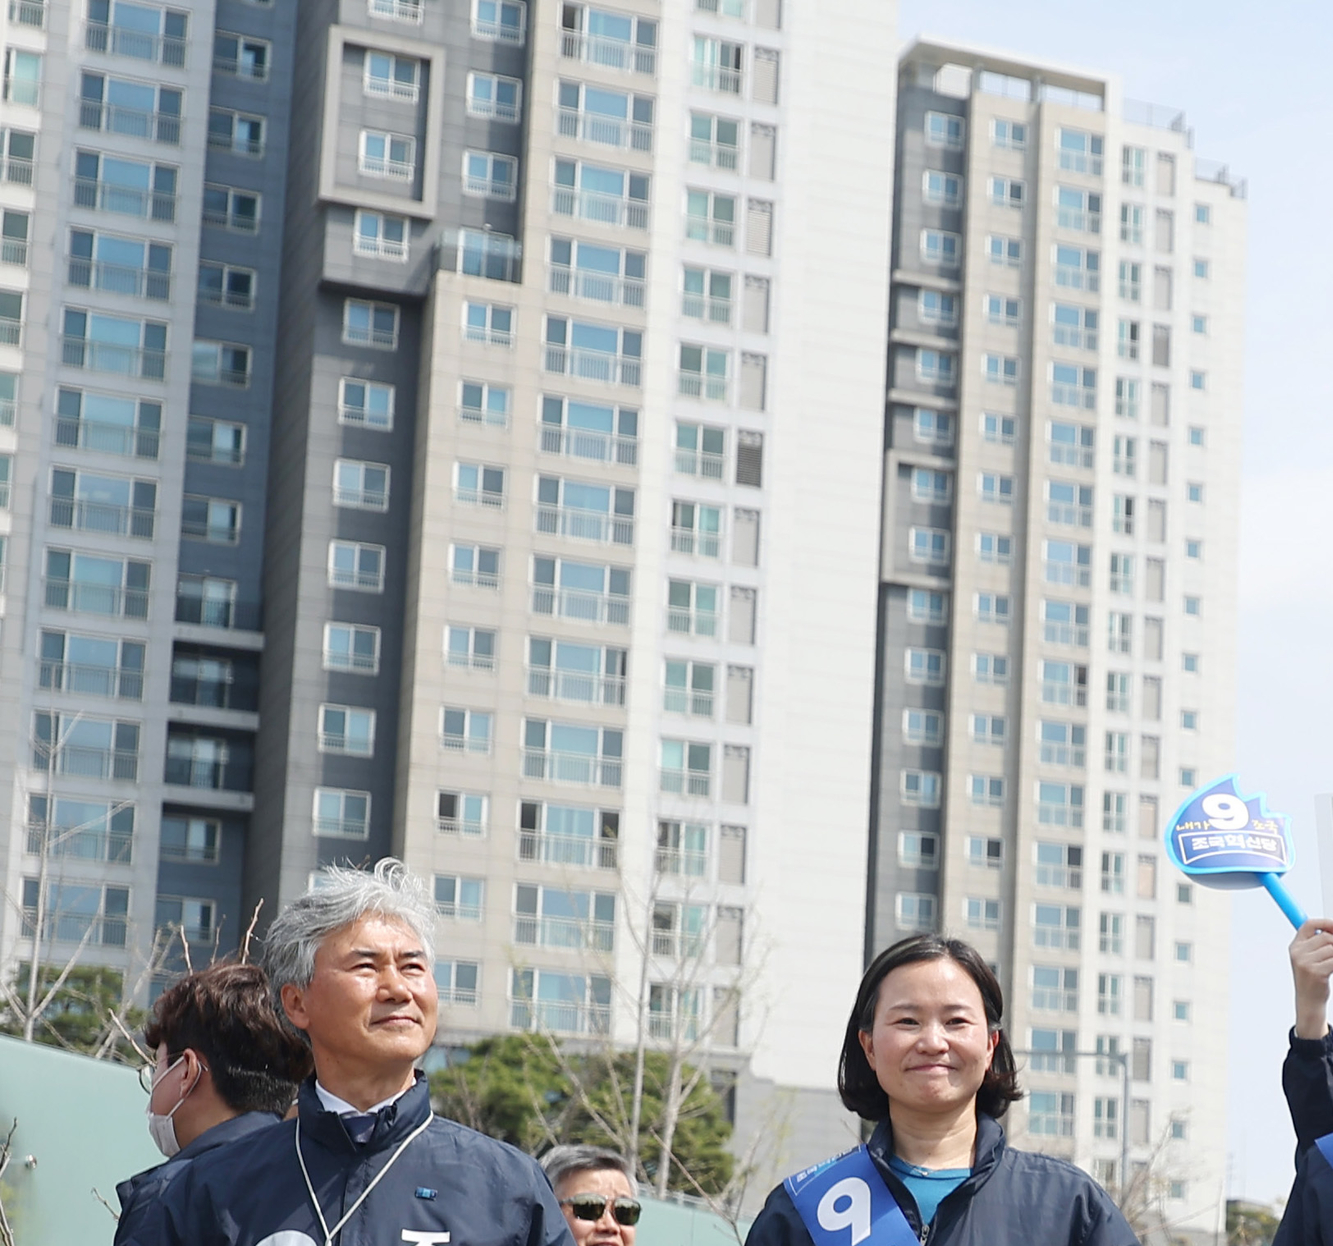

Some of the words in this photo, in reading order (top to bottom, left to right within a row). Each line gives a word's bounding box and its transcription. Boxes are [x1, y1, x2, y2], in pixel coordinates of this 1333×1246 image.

[1202, 793, 1249, 831] 9
[1191, 834, 1278, 852] 조국혁신당
[817, 1176, 871, 1246] 9
